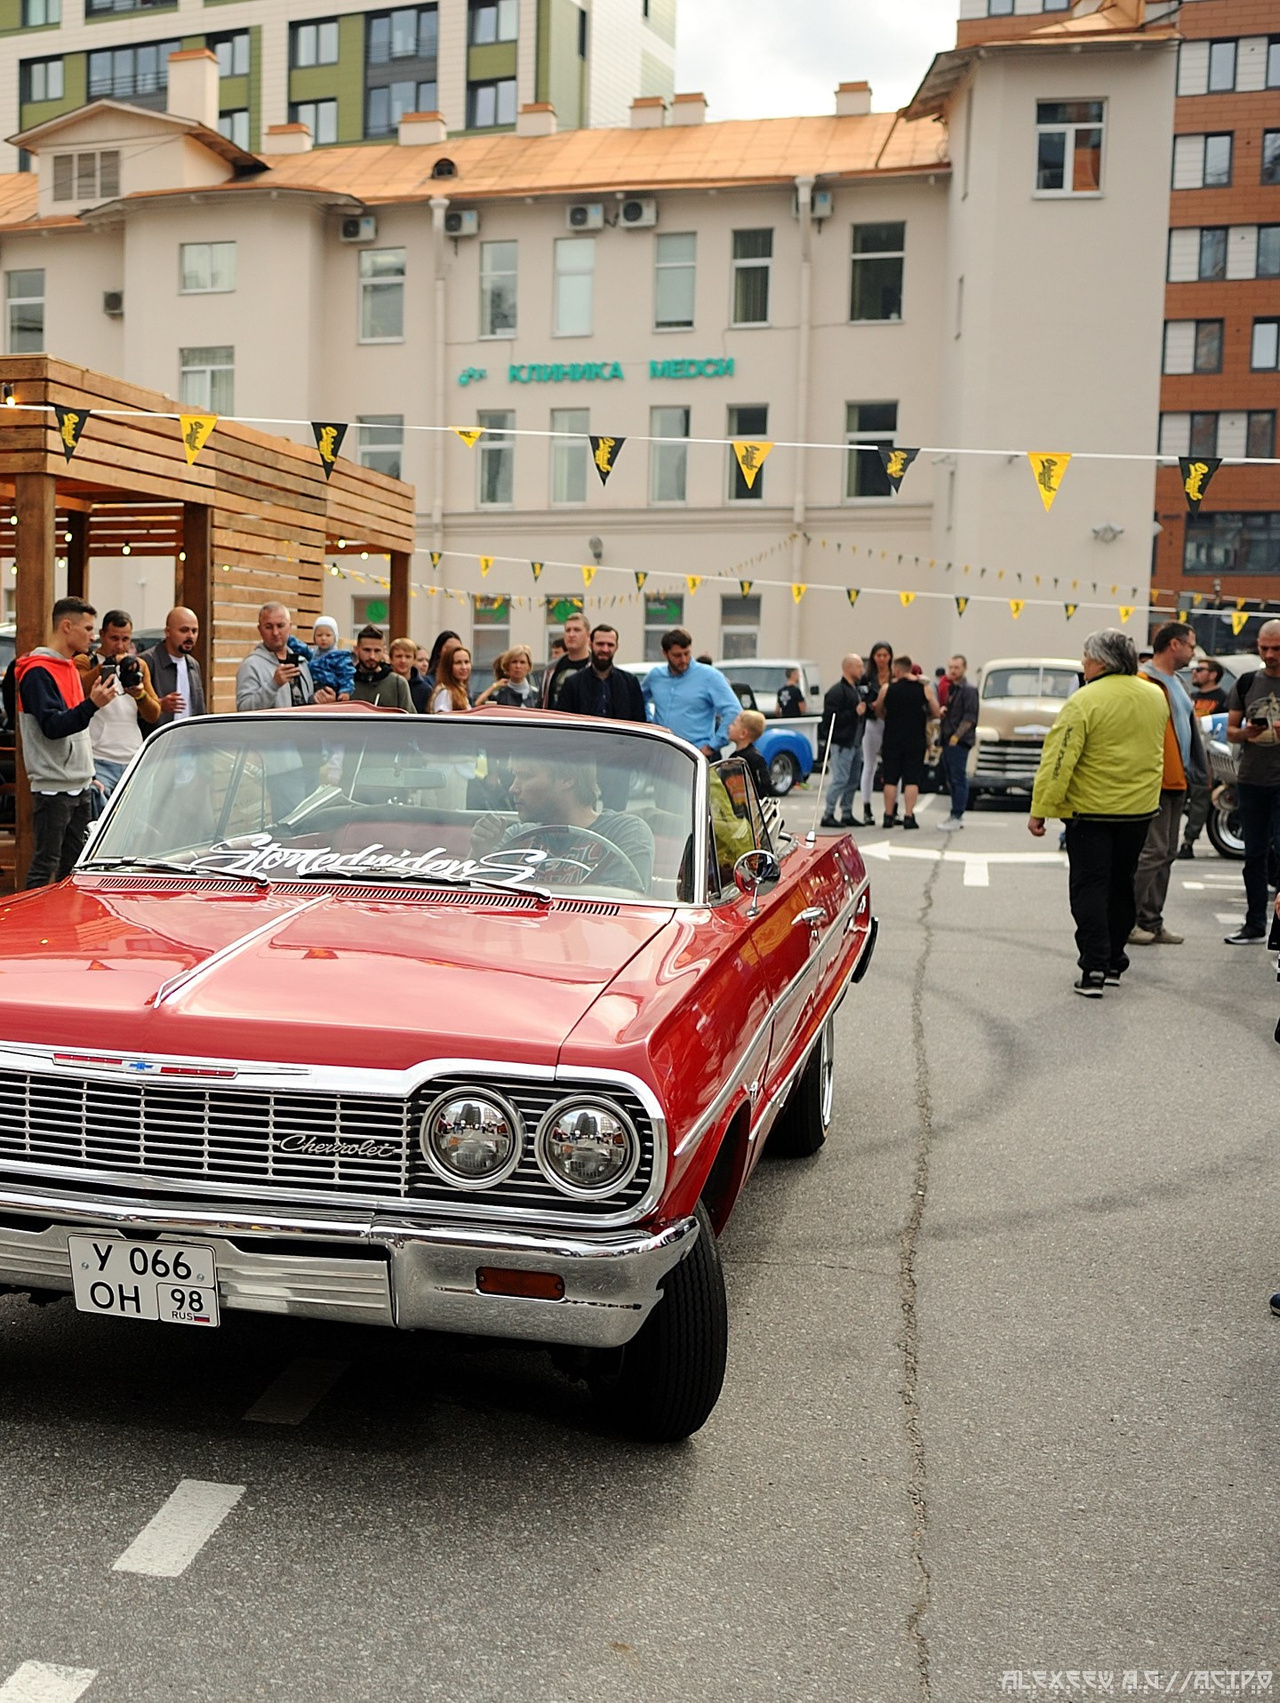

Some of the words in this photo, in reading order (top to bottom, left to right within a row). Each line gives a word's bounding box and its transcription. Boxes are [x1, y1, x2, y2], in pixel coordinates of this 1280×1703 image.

[508, 361, 623, 383] КЛИНИКА
[280, 1133, 396, 1158] Chevrolet
[129, 1247, 192, 1280] 066
[90, 1281, 141, 1314] ОН
[170, 1288, 204, 1313] 98
[171, 1310, 193, 1321] RUS
